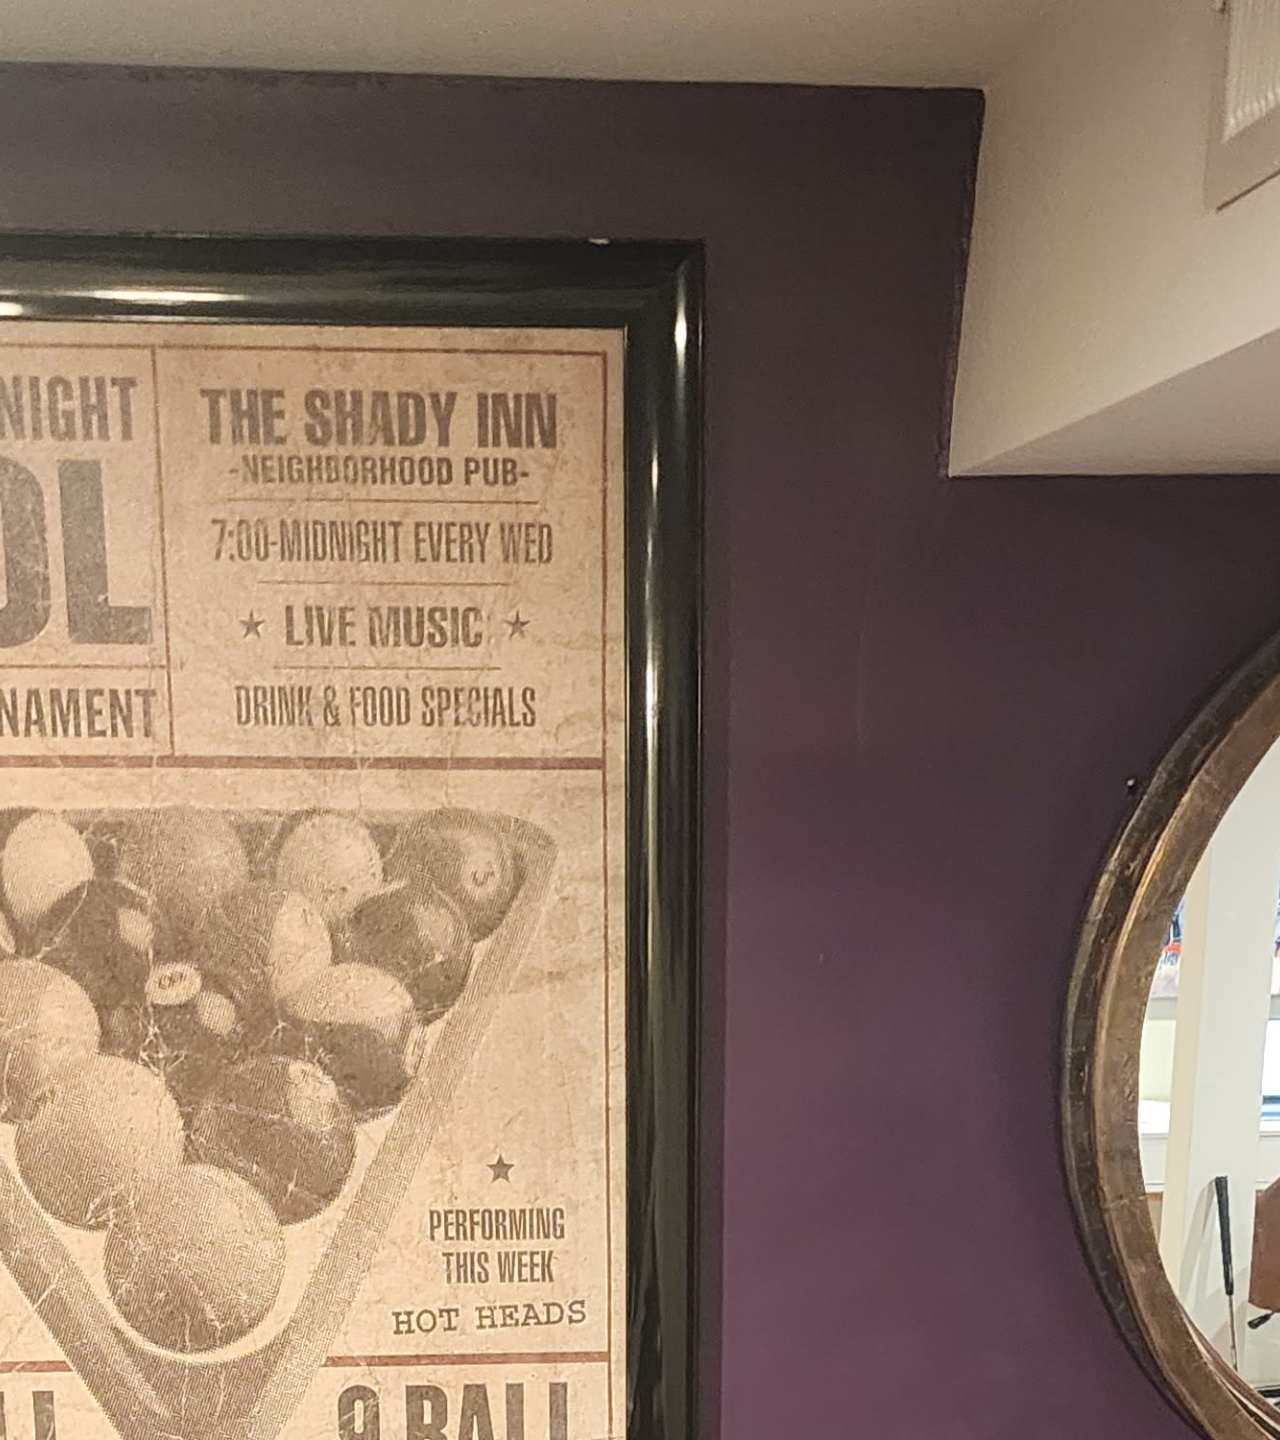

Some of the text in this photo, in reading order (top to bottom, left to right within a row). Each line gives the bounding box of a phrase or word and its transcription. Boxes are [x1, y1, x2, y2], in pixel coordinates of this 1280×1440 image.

[200, 388, 557, 449] THE SHADY INN
[211, 519, 553, 566] 7:00-MIDNIGHT EVERY WED
[284, 605, 483, 648] LIVE MUSIC
[235, 686, 536, 728] DRINK & FOOD SPECIALS
[429, 1208, 566, 1242] PERFORMING
[443, 1250, 555, 1284] THIS WEEK
[392, 1300, 587, 1336] HOT HEADS
